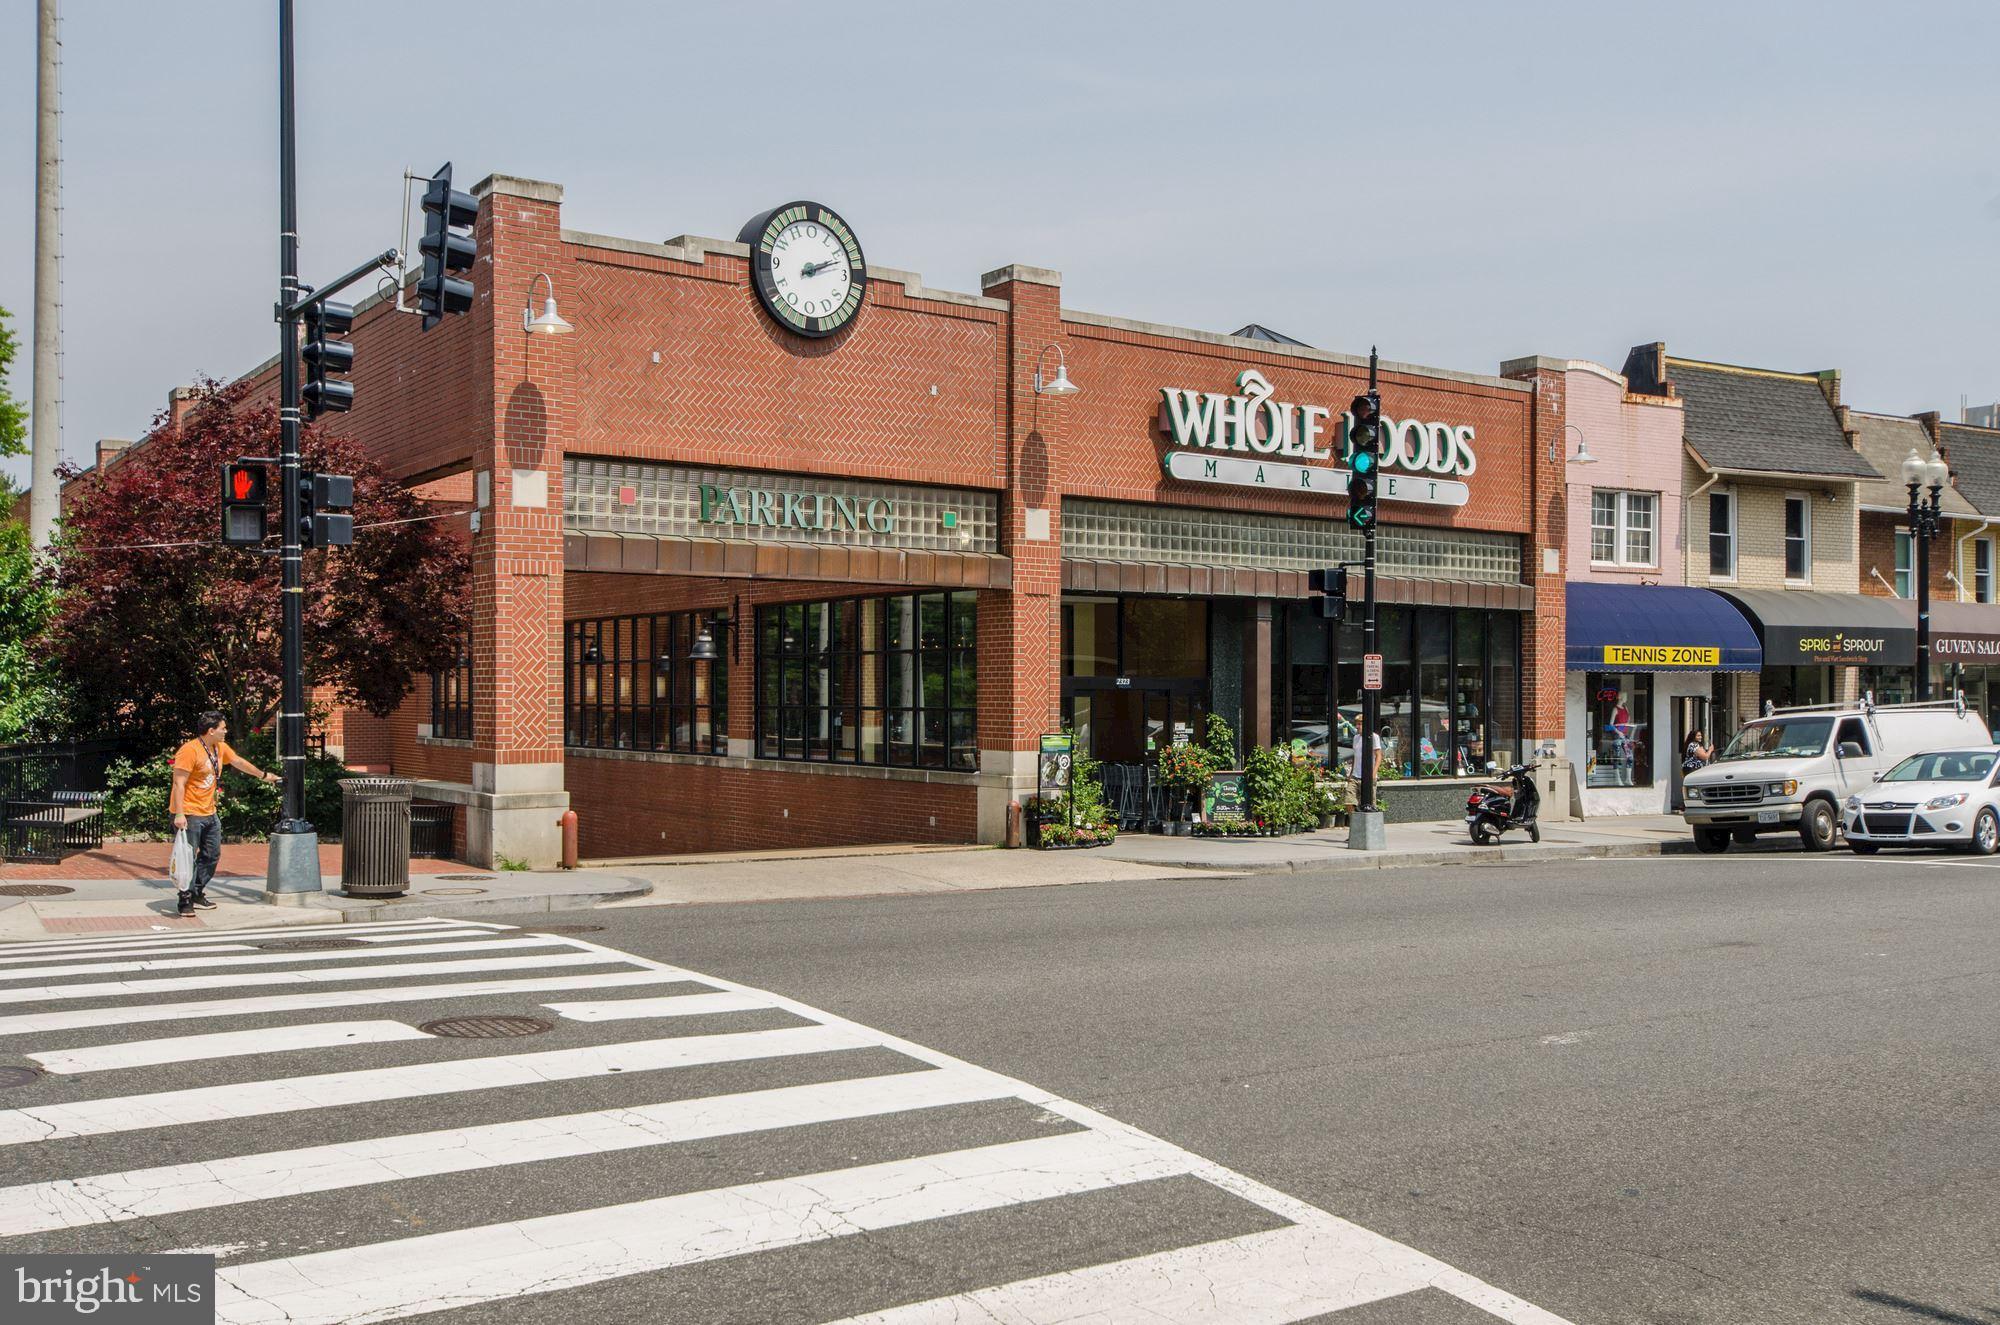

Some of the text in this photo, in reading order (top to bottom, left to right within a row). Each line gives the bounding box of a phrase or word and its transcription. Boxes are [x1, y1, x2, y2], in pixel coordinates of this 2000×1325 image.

[775, 225, 844, 261] WHOLE
[772, 257, 780, 269] 9
[840, 269, 848, 281] 3
[776, 278, 842, 315] FOODS
[1159, 370, 1333, 459] WHOLE
[698, 485, 894, 534] PARKING
[1799, 638, 1831, 652] SPRIG
[1843, 639, 1885, 652] SPROUT
[1936, 638, 1975, 654] GUVEN
[1612, 648, 1712, 662] TENNIS ZONE
